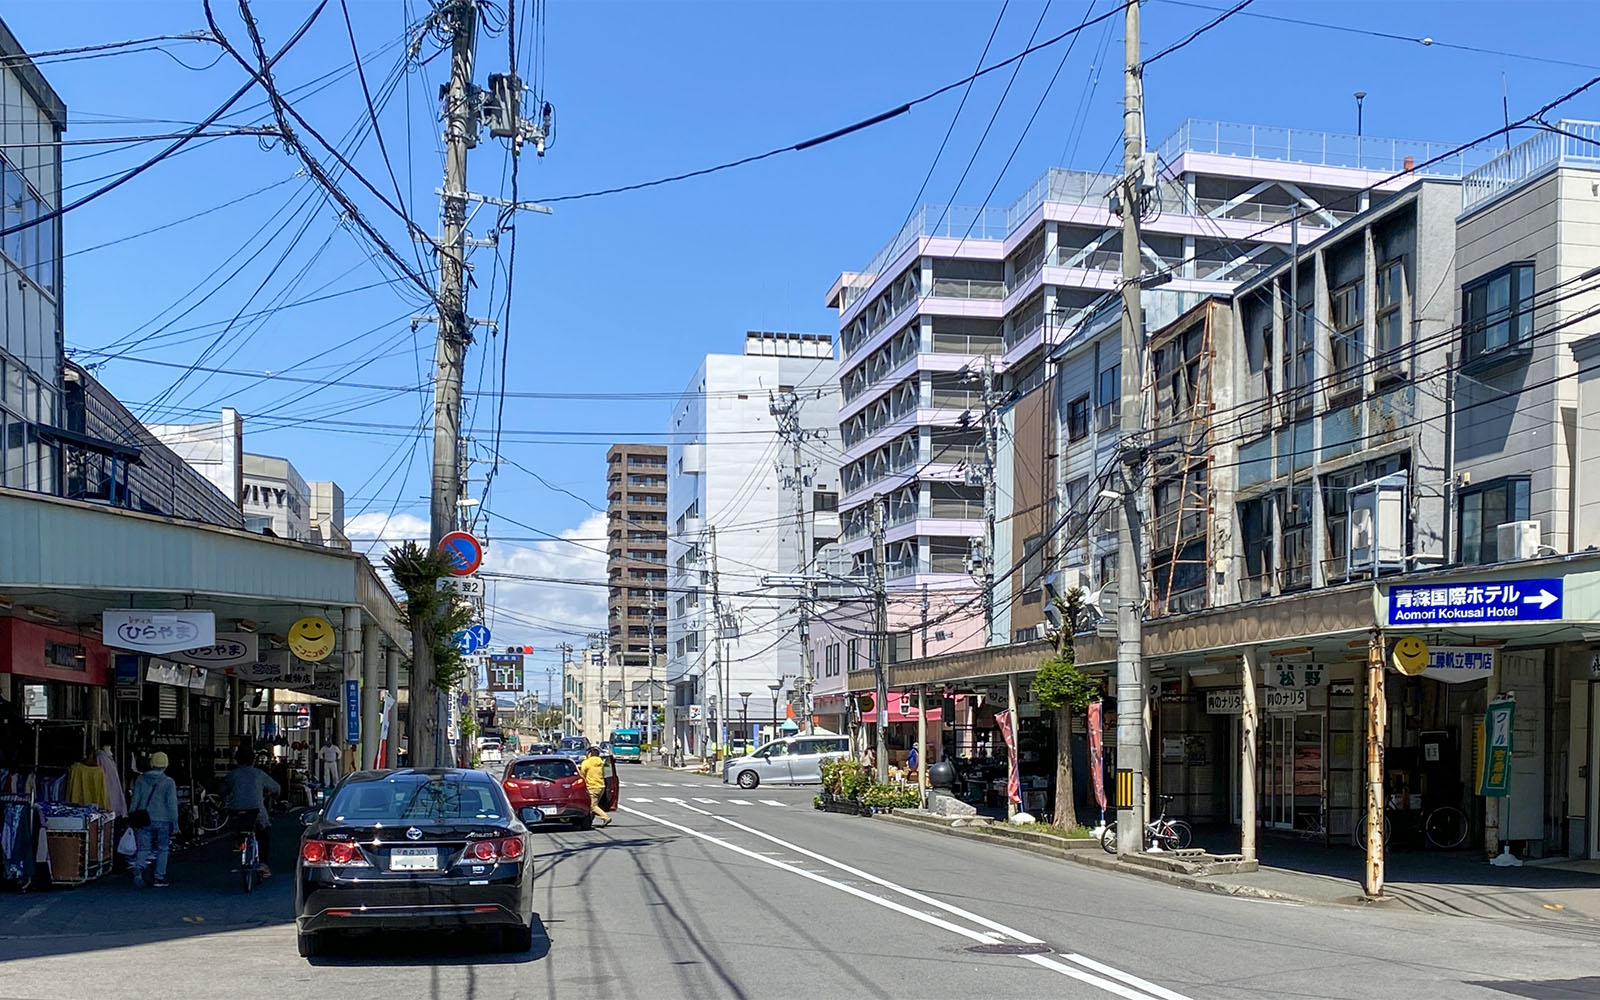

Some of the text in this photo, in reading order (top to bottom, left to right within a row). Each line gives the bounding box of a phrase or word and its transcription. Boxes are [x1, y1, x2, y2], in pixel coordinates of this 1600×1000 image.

[1395, 585, 1520, 608] 青森国際ホテル
[1395, 605, 1518, 620] Aomori Kokusai Hotel
[126, 625, 191, 639] ひらやま
[1427, 651, 1492, 669] 工藤帆立専門店
[1279, 671, 1321, 686] 松野
[1495, 711, 1508, 746] クール
